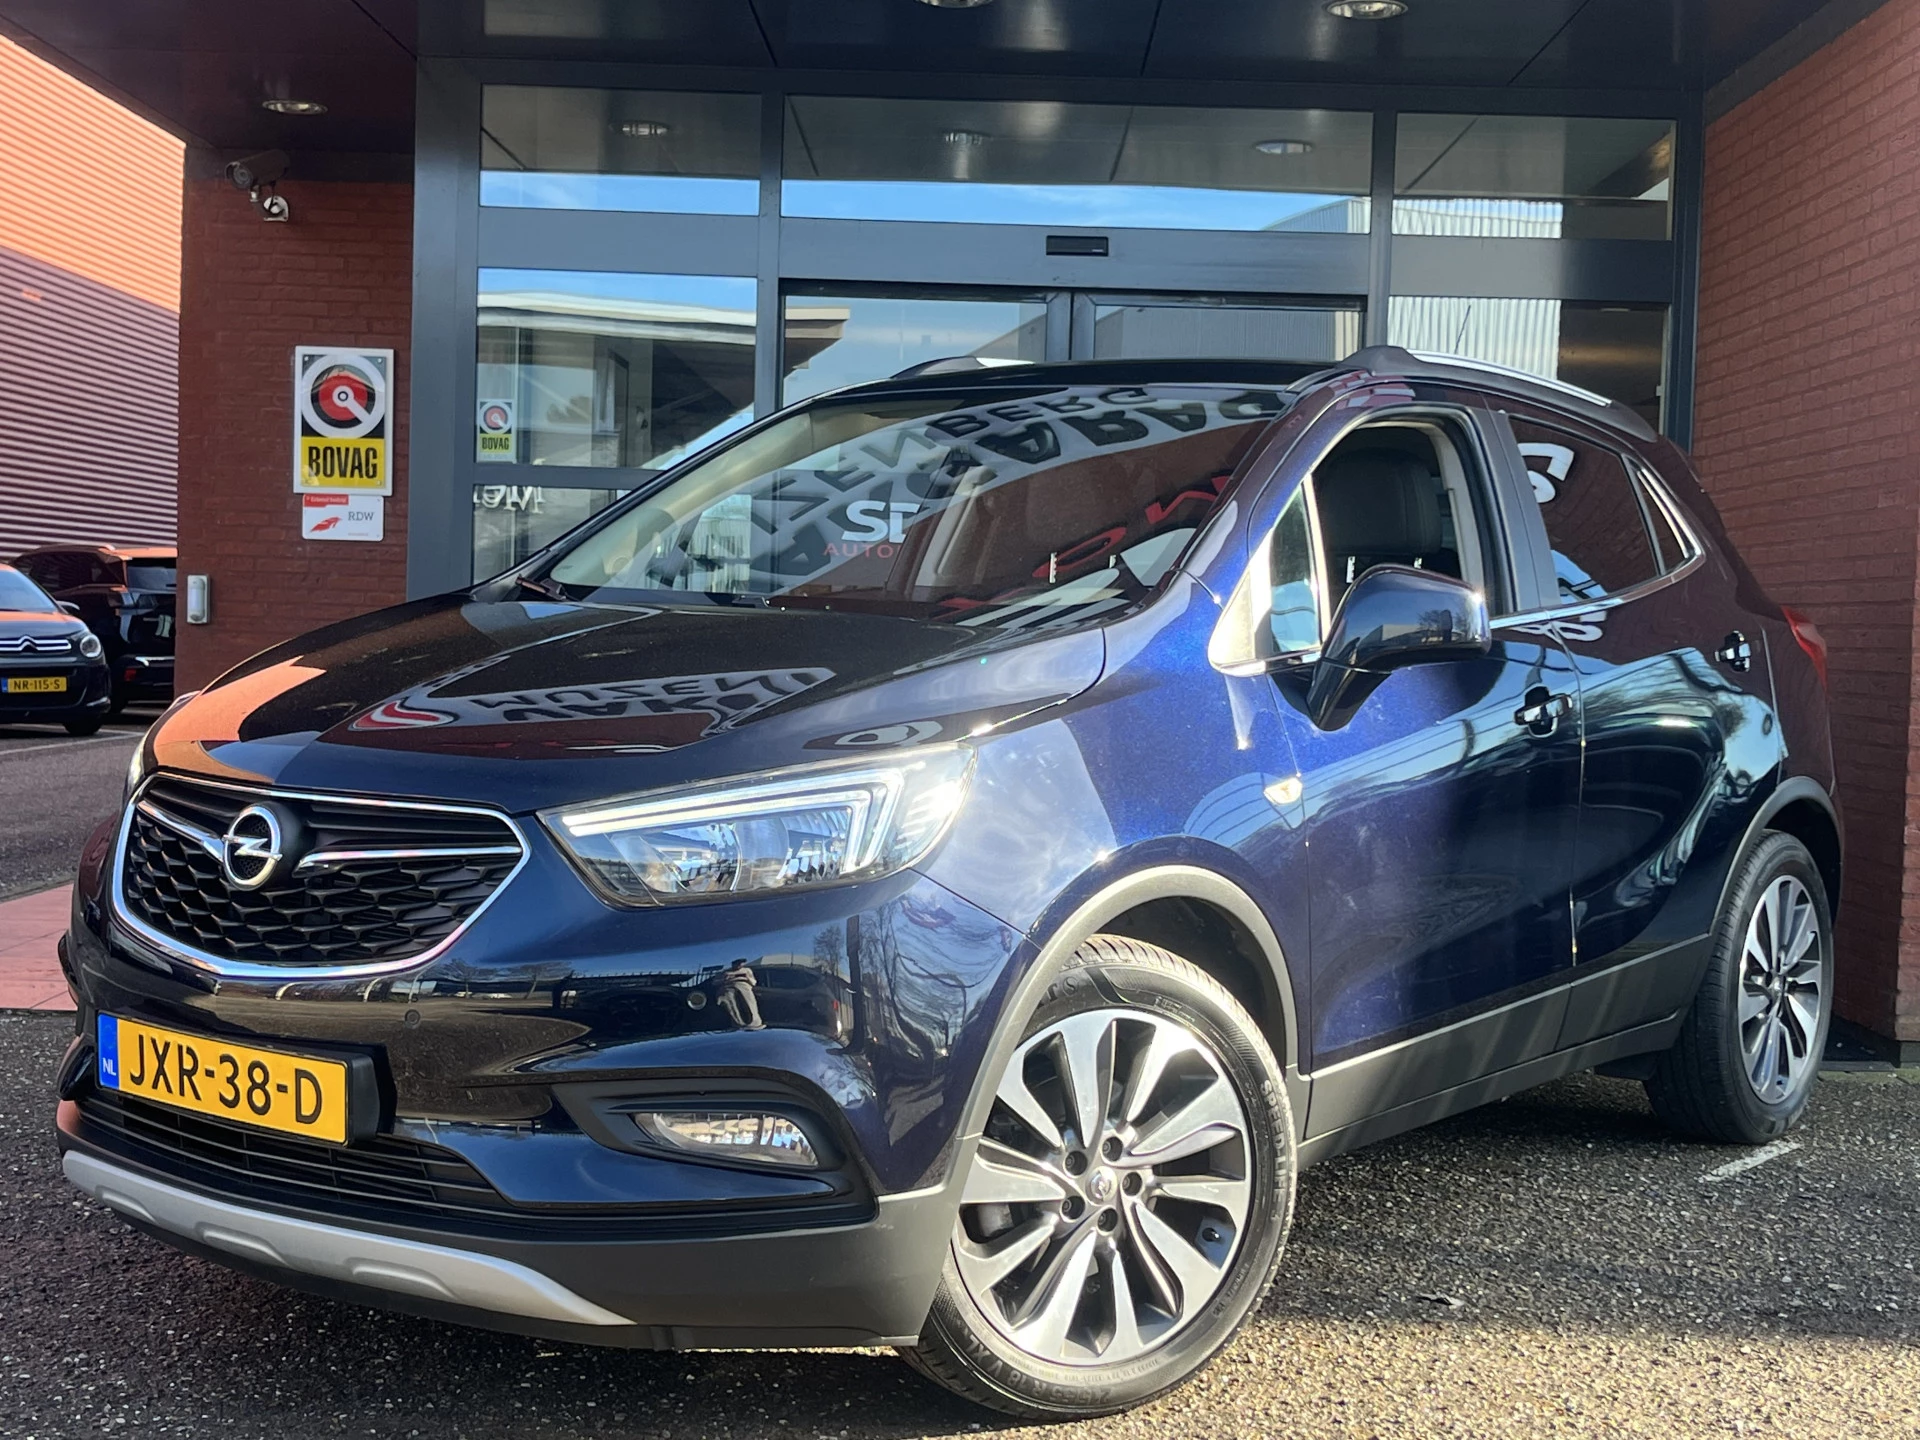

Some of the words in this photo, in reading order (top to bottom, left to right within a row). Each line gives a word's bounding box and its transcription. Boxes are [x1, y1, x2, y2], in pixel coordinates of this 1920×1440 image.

[482, 437, 510, 451] BOVAG
[307, 446, 378, 479] BOVAG
[348, 511, 375, 521] RDW
[823, 543, 901, 559] AUTO
[13, 679, 60, 690] NR-115-S
[102, 1057, 117, 1077] NL
[130, 1034, 323, 1125] JXR-38-D
